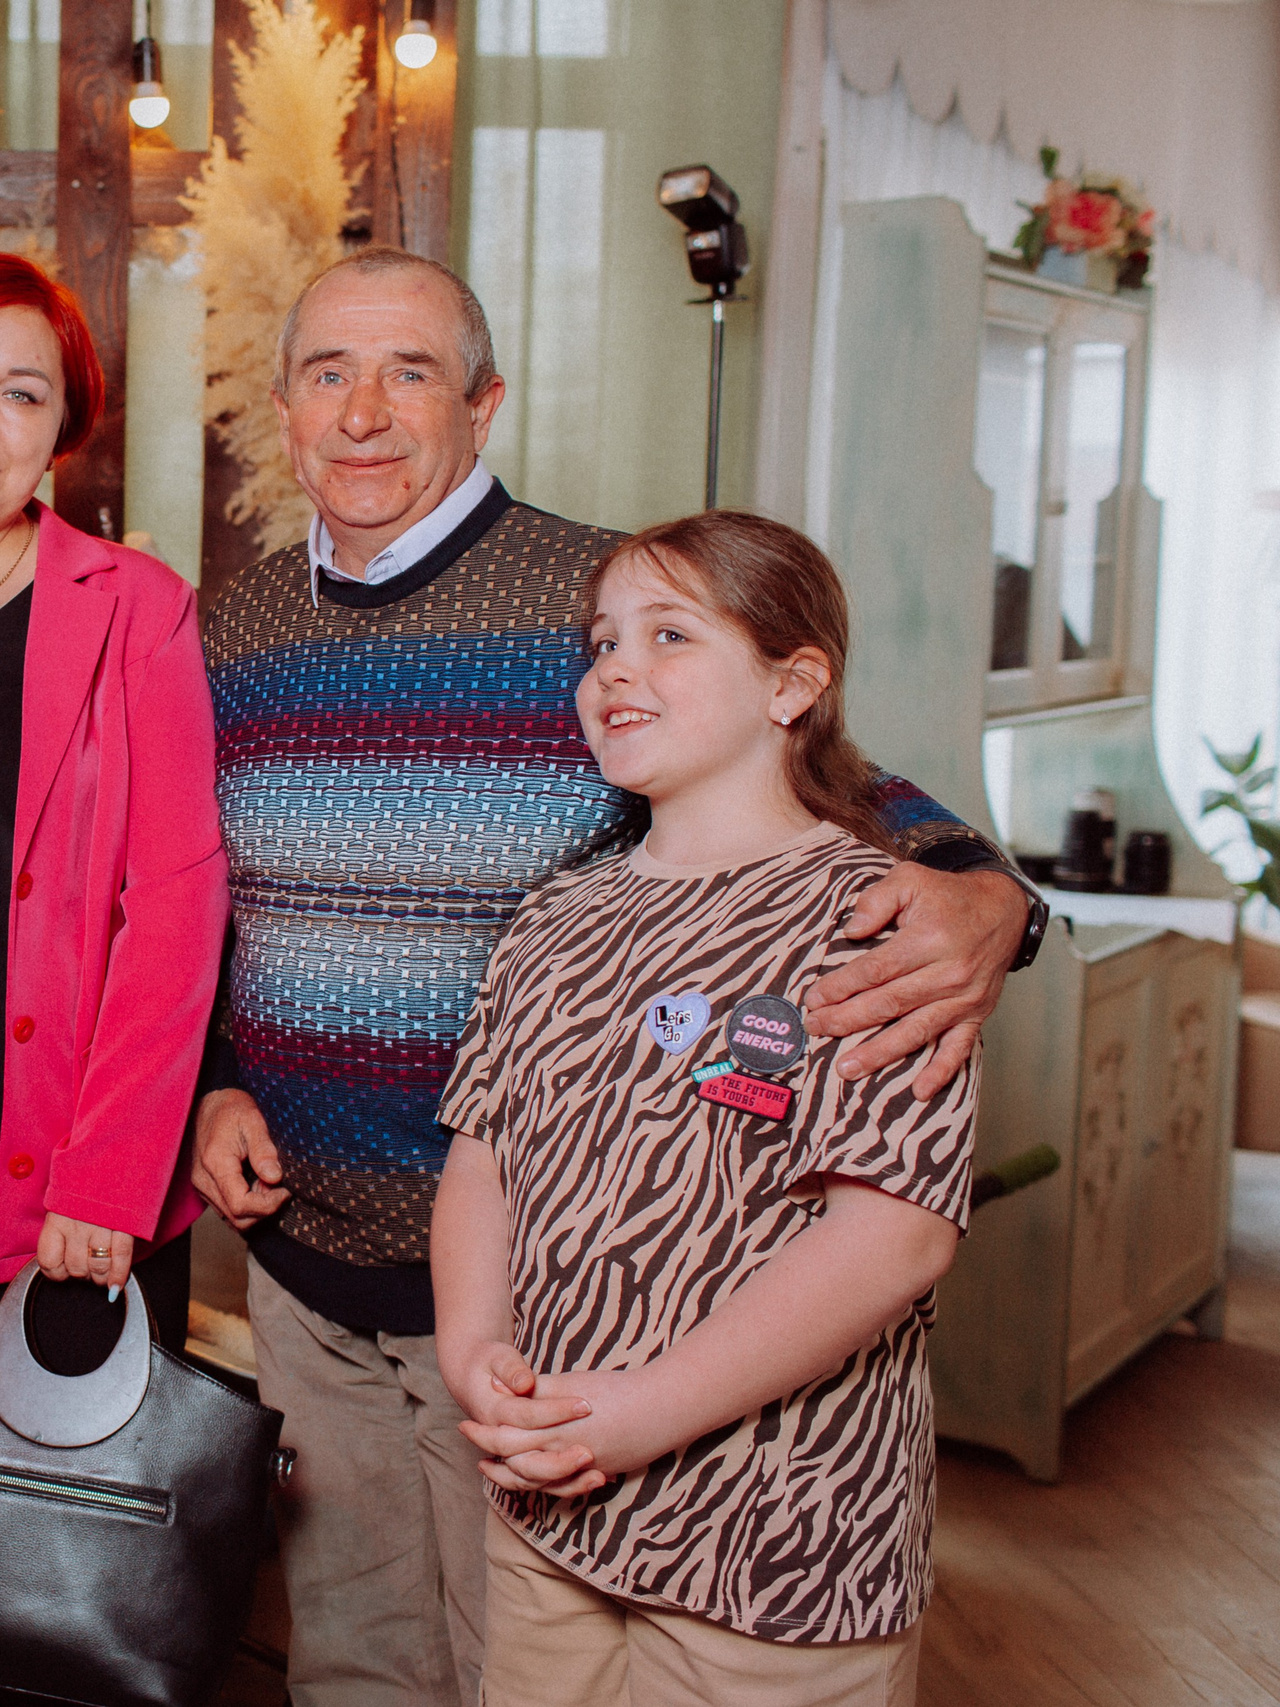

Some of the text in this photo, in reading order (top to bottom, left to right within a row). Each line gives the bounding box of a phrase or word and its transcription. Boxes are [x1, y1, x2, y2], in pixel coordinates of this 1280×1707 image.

[742, 1014, 791, 1036] GOOD
[732, 1029, 796, 1056] ENERGY
[694, 1063, 733, 1080] UNREAL
[706, 1084, 756, 1107] IS YOURS
[721, 1076, 787, 1103] THE FUTURE
